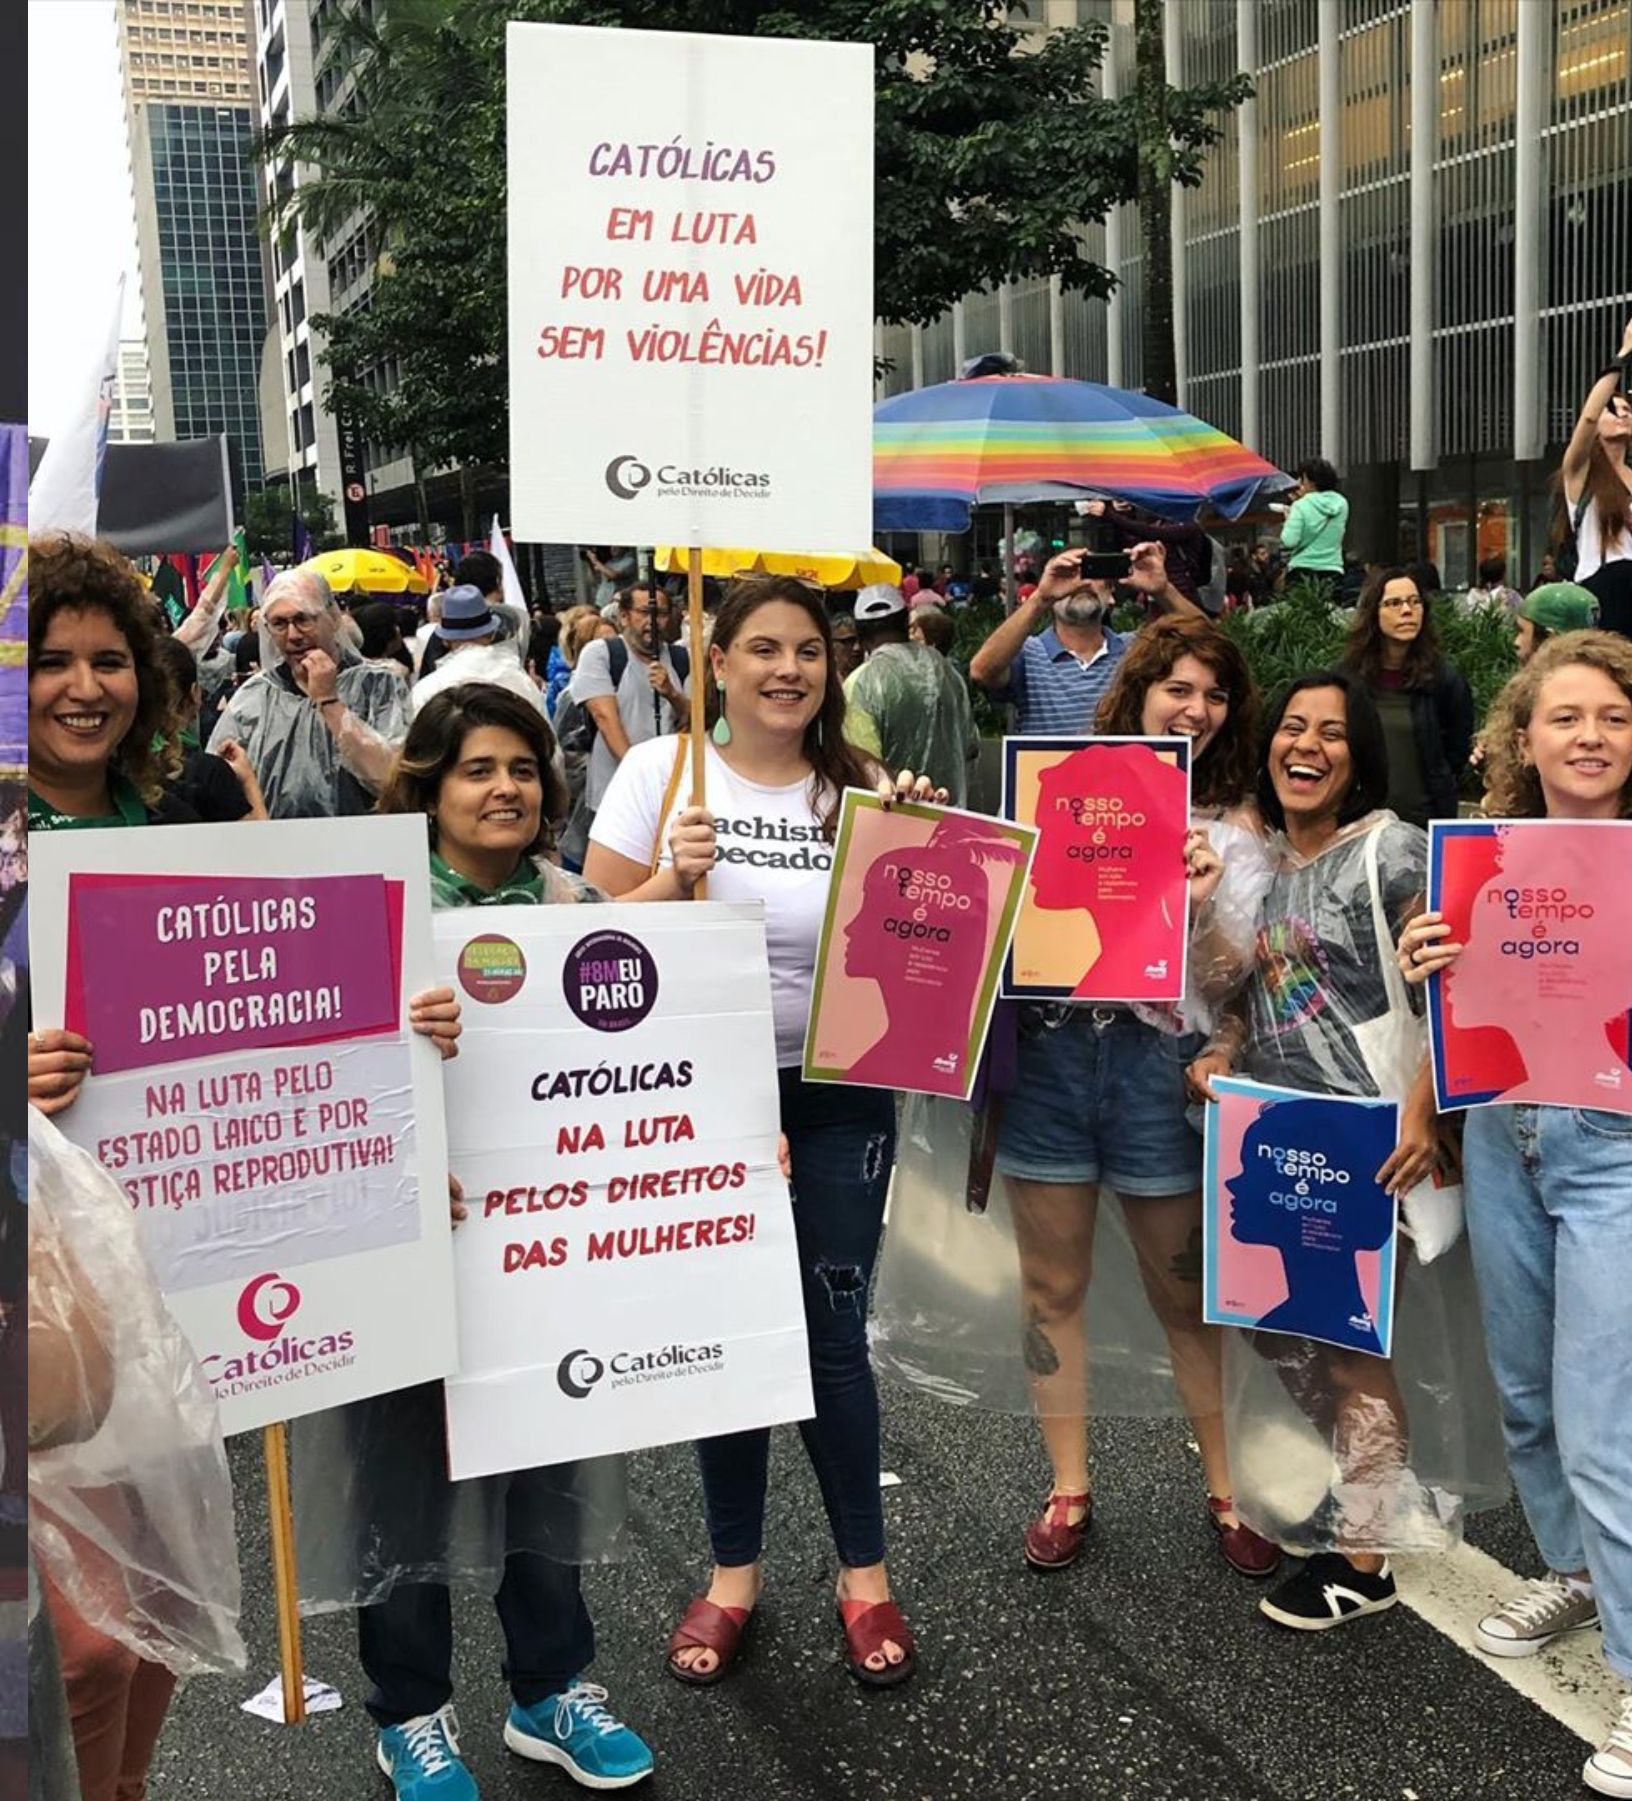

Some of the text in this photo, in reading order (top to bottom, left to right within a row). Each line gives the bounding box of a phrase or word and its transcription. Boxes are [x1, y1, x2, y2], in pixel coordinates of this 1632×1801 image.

[588, 135, 776, 183] CATÓLICAS
[606, 207, 757, 245] EM LUTA
[561, 266, 802, 306] POR UMA VIDA
[537, 318, 827, 368] SEM VIOLÊNCIAS!
[656, 465, 771, 487] Católicas
[681, 487, 718, 497] Direito
[733, 488, 771, 499] Decidir
[1055, 797, 1124, 812] nosso
[1073, 809, 1146, 830] tempo
[1092, 827, 1107, 845] é
[1066, 845, 1133, 863] agora
[883, 864, 952, 889] nosso
[898, 880, 971, 910] tempo
[1486, 888, 1567, 904] nosso
[156, 896, 316, 945] CATÓLICAS
[912, 903, 928, 921] é
[1506, 901, 1595, 922] tempo
[883, 918, 951, 942] agora
[1531, 921, 1546, 939] é
[1500, 940, 1579, 959] agora
[203, 946, 277, 986] PELA
[579, 958, 642, 983] #8MEU
[580, 982, 644, 1011] PARO
[139, 987, 342, 1044] DEMOCRACIA!
[146, 1061, 332, 1118] NA LUTA PELO
[531, 1060, 693, 1101] CATÓLICAS
[98, 1097, 368, 1168] ESTADO LAICO E POR
[555, 1114, 695, 1155] NA LUTA
[1257, 1143, 1327, 1166] nosso
[124, 1134, 394, 1210] STIÇA REPRODUTIVA!
[1275, 1159, 1350, 1185] tempo
[483, 1162, 747, 1218] PELOS DIREITOS
[1294, 1178, 1309, 1195] é
[1269, 1190, 1338, 1213] agora
[502, 1213, 755, 1273] DAS MULHERES!
[609, 1343, 724, 1375] Católicas
[688, 1360, 725, 1376] Decidir
[231, 1375, 281, 1397] Direito
[285, 1367, 302, 1383] de
[304, 1354, 356, 1377] Decidir
